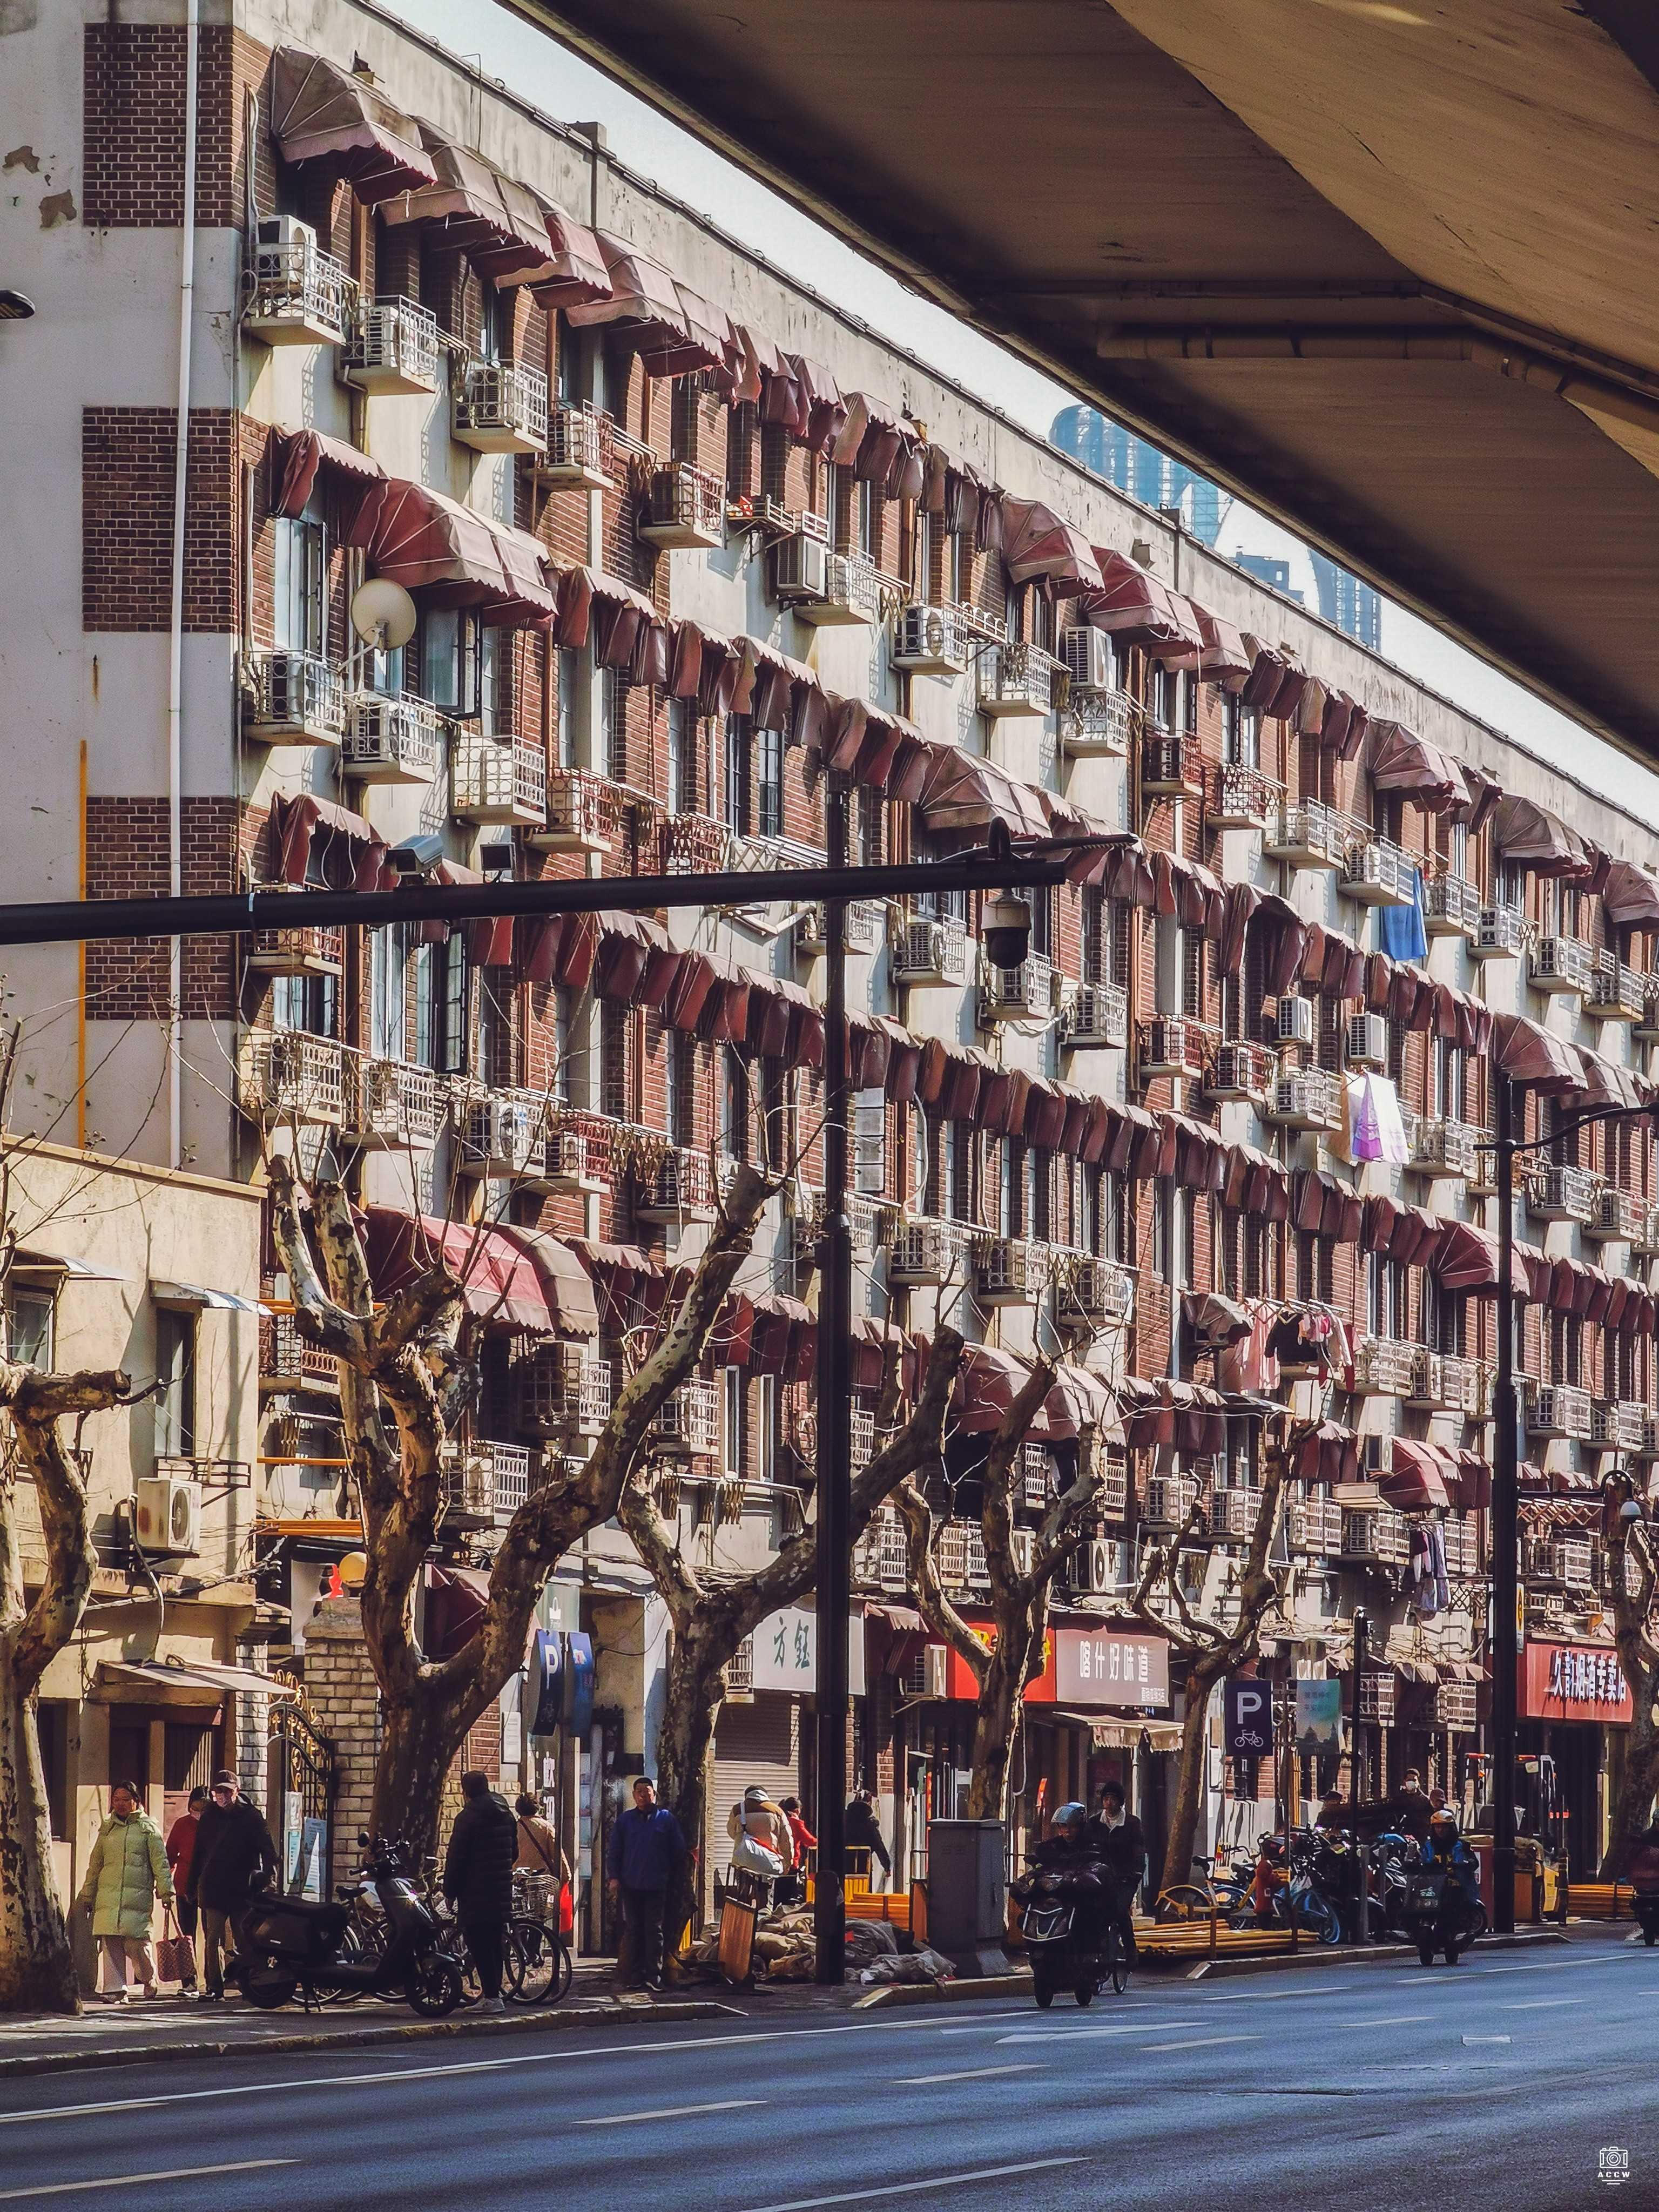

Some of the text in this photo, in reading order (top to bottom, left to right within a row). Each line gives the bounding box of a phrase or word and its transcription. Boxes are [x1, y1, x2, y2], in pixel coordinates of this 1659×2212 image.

[544, 1644, 558, 1690] P
[1080, 1641, 1148, 1682] 喀什好味道
[1237, 1691, 1262, 1724] P
